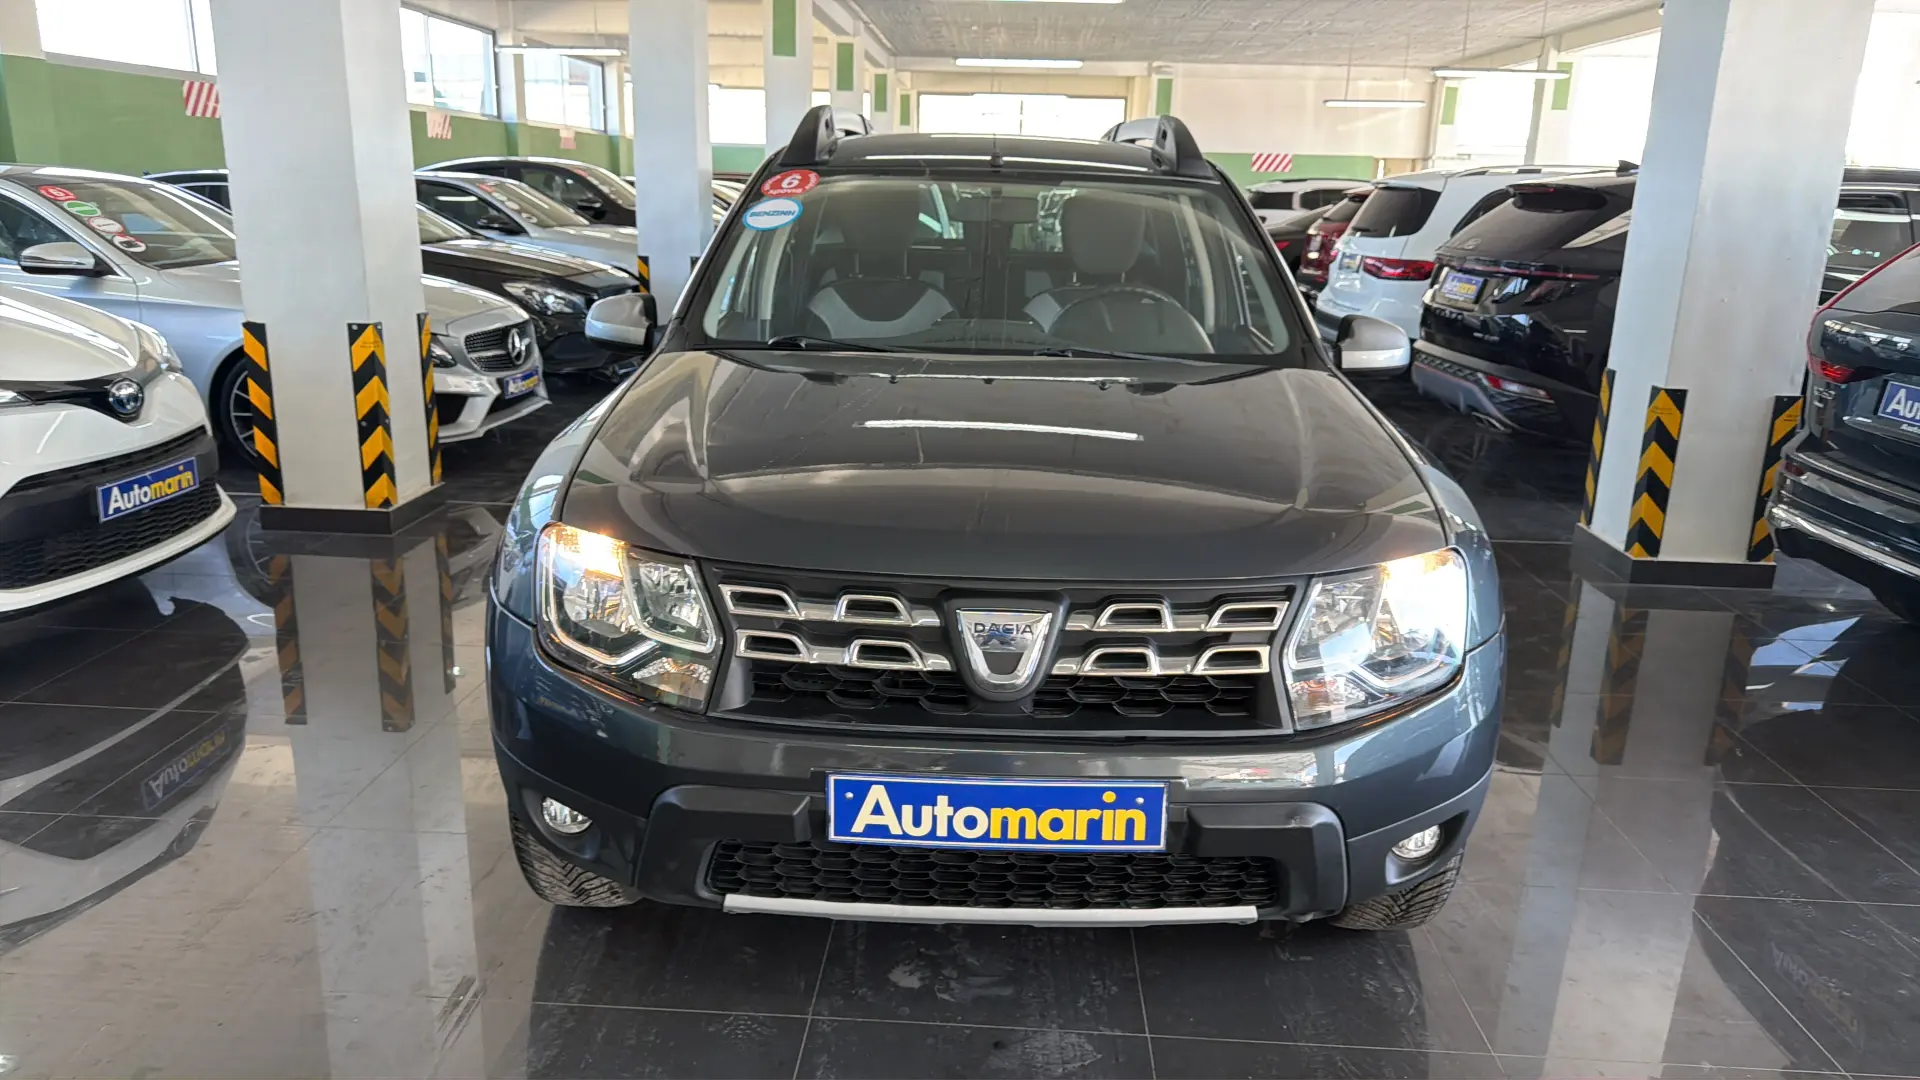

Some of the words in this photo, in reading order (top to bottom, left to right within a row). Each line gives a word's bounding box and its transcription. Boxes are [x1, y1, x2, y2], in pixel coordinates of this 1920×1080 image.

[781, 174, 802, 189] 6
[108, 465, 194, 515] Automarin
[974, 622, 1034, 636] DACIA
[851, 784, 1147, 841] Automarin
